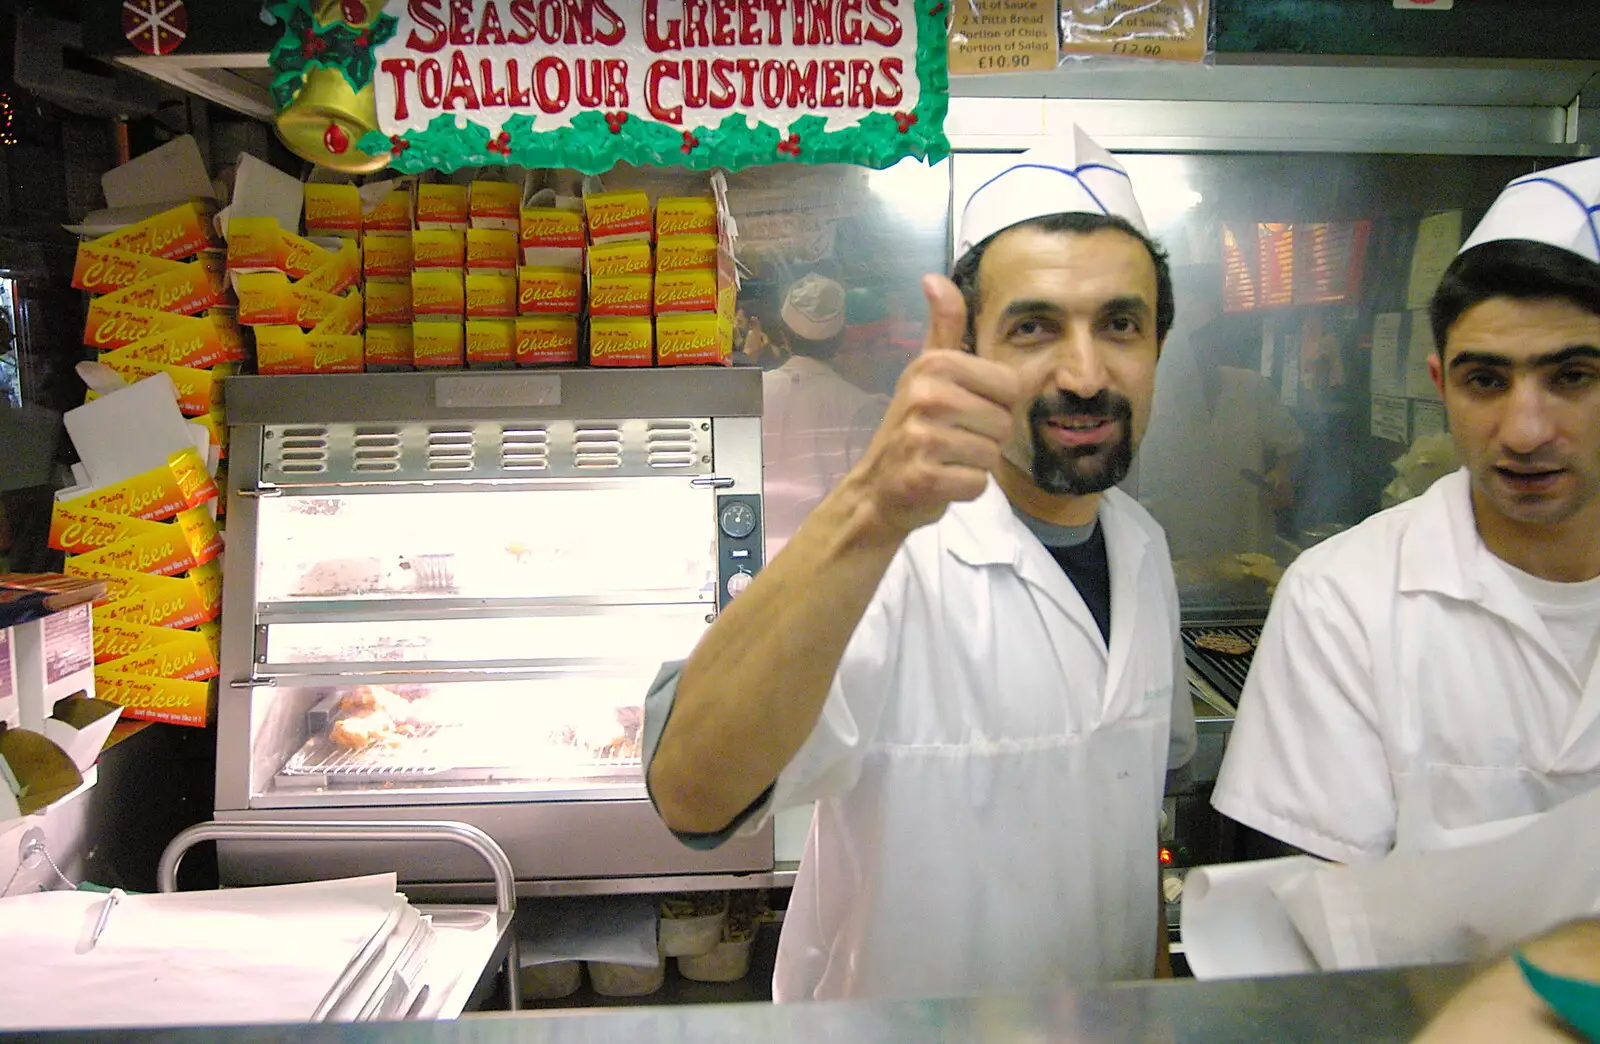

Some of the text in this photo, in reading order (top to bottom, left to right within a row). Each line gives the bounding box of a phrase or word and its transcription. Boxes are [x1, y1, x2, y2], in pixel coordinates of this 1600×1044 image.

[1004, 0, 1037, 9] Sauce
[406, 0, 903, 52] SEASONS GREETINGS
[962, 16, 969, 25] 2
[981, 15, 1007, 25] Pitta
[1010, 14, 1044, 25] Bread
[1004, 28, 1016, 37] of
[1018, 27, 1048, 38] Chips
[959, 41, 1049, 54] Portion of Salad
[978, 55, 1030, 69] £10.90
[644, 58, 903, 125] CUSTOMERS
[589, 206, 647, 230] Chicken
[657, 216, 713, 236] Chicken
[522, 223, 580, 240] Chicken
[657, 249, 714, 272] Chicken
[520, 285, 577, 305] Chicken
[591, 289, 649, 309] Chicken
[655, 286, 713, 305] Chicken
[516, 335, 573, 356] Chicken
[591, 337, 649, 357] Chicken
[659, 335, 716, 357] Chicken
[88, 499, 97, 509] &
[99, 556, 106, 564] &
[109, 609, 117, 619] &
[102, 625, 110, 633] &
[122, 663, 129, 672] &
